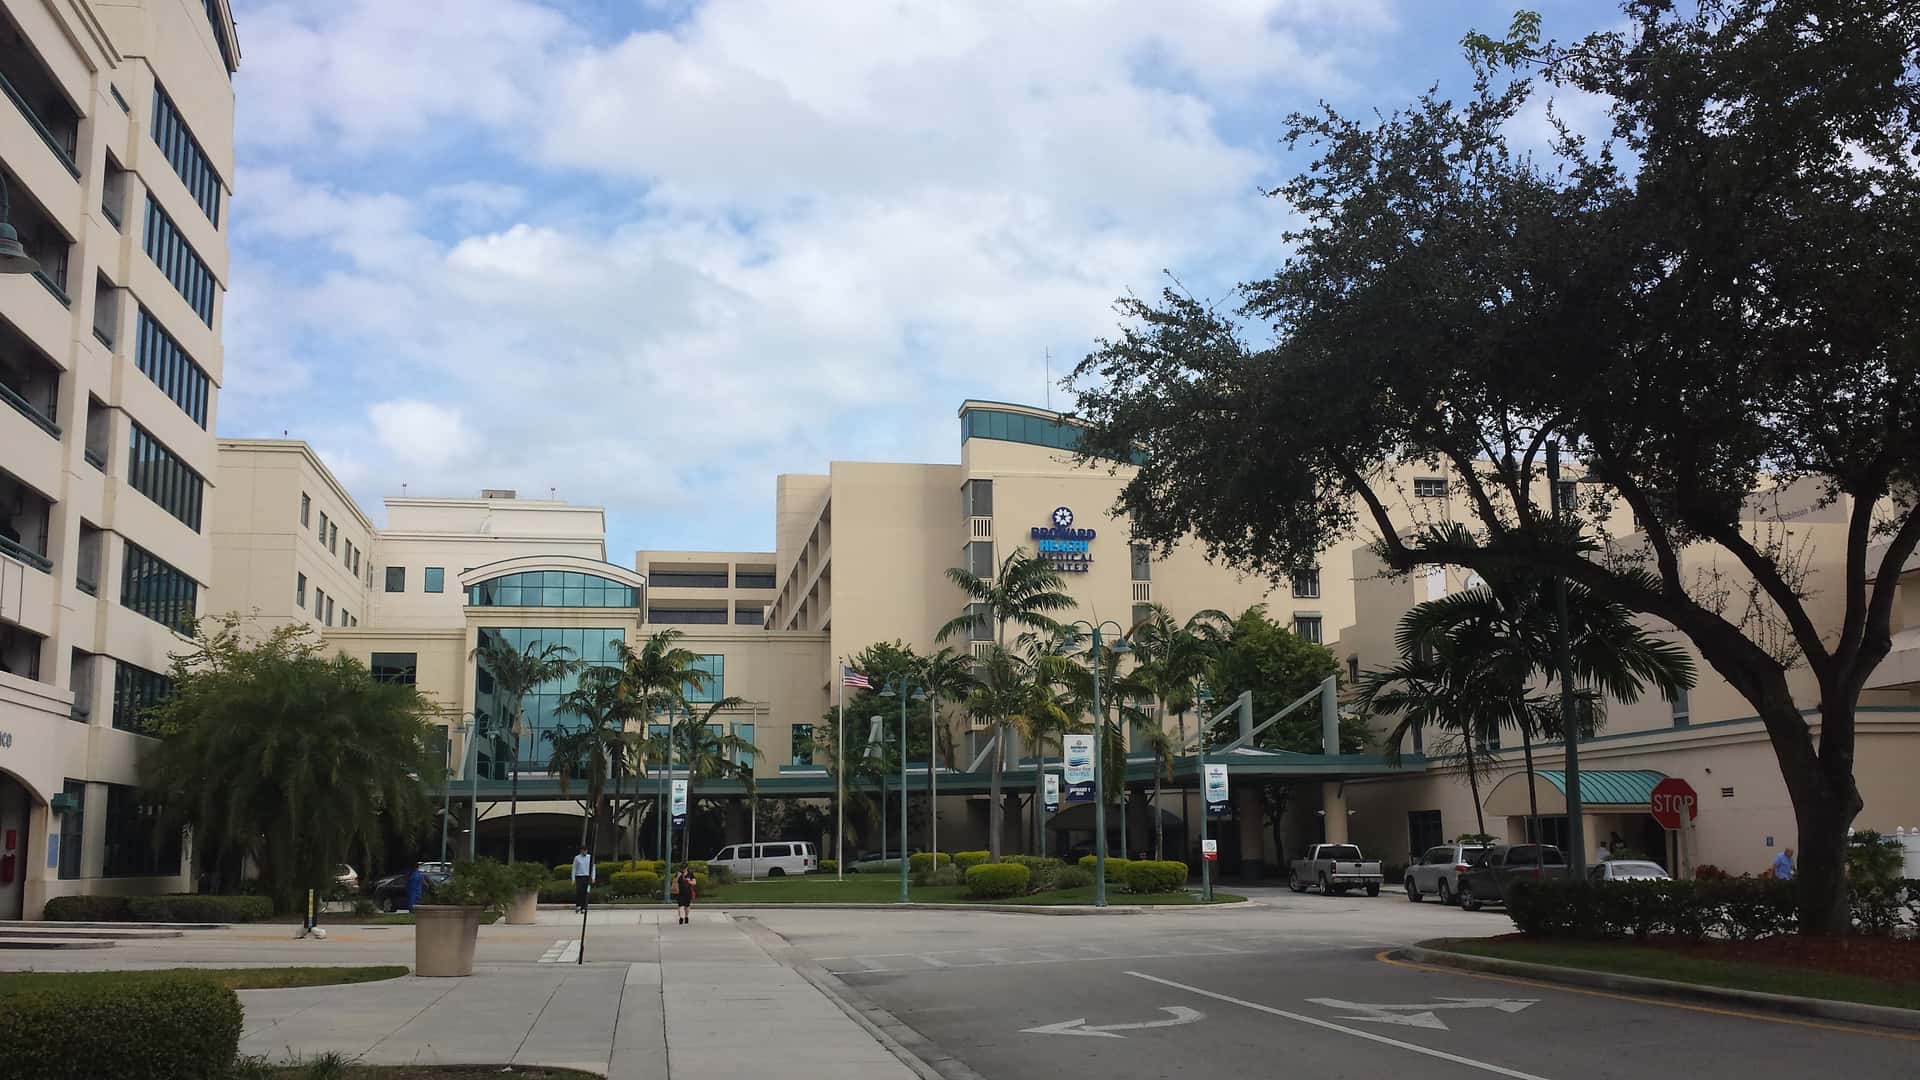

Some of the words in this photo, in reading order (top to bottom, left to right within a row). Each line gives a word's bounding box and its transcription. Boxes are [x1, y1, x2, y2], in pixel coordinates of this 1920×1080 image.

[1031, 527, 1096, 540] BROWARD
[1040, 539, 1088, 552] HEALTH
[1037, 552, 1095, 562] MEDICAL
[1045, 563, 1089, 573] ENTER
[1654, 794, 1694, 813] STOP
